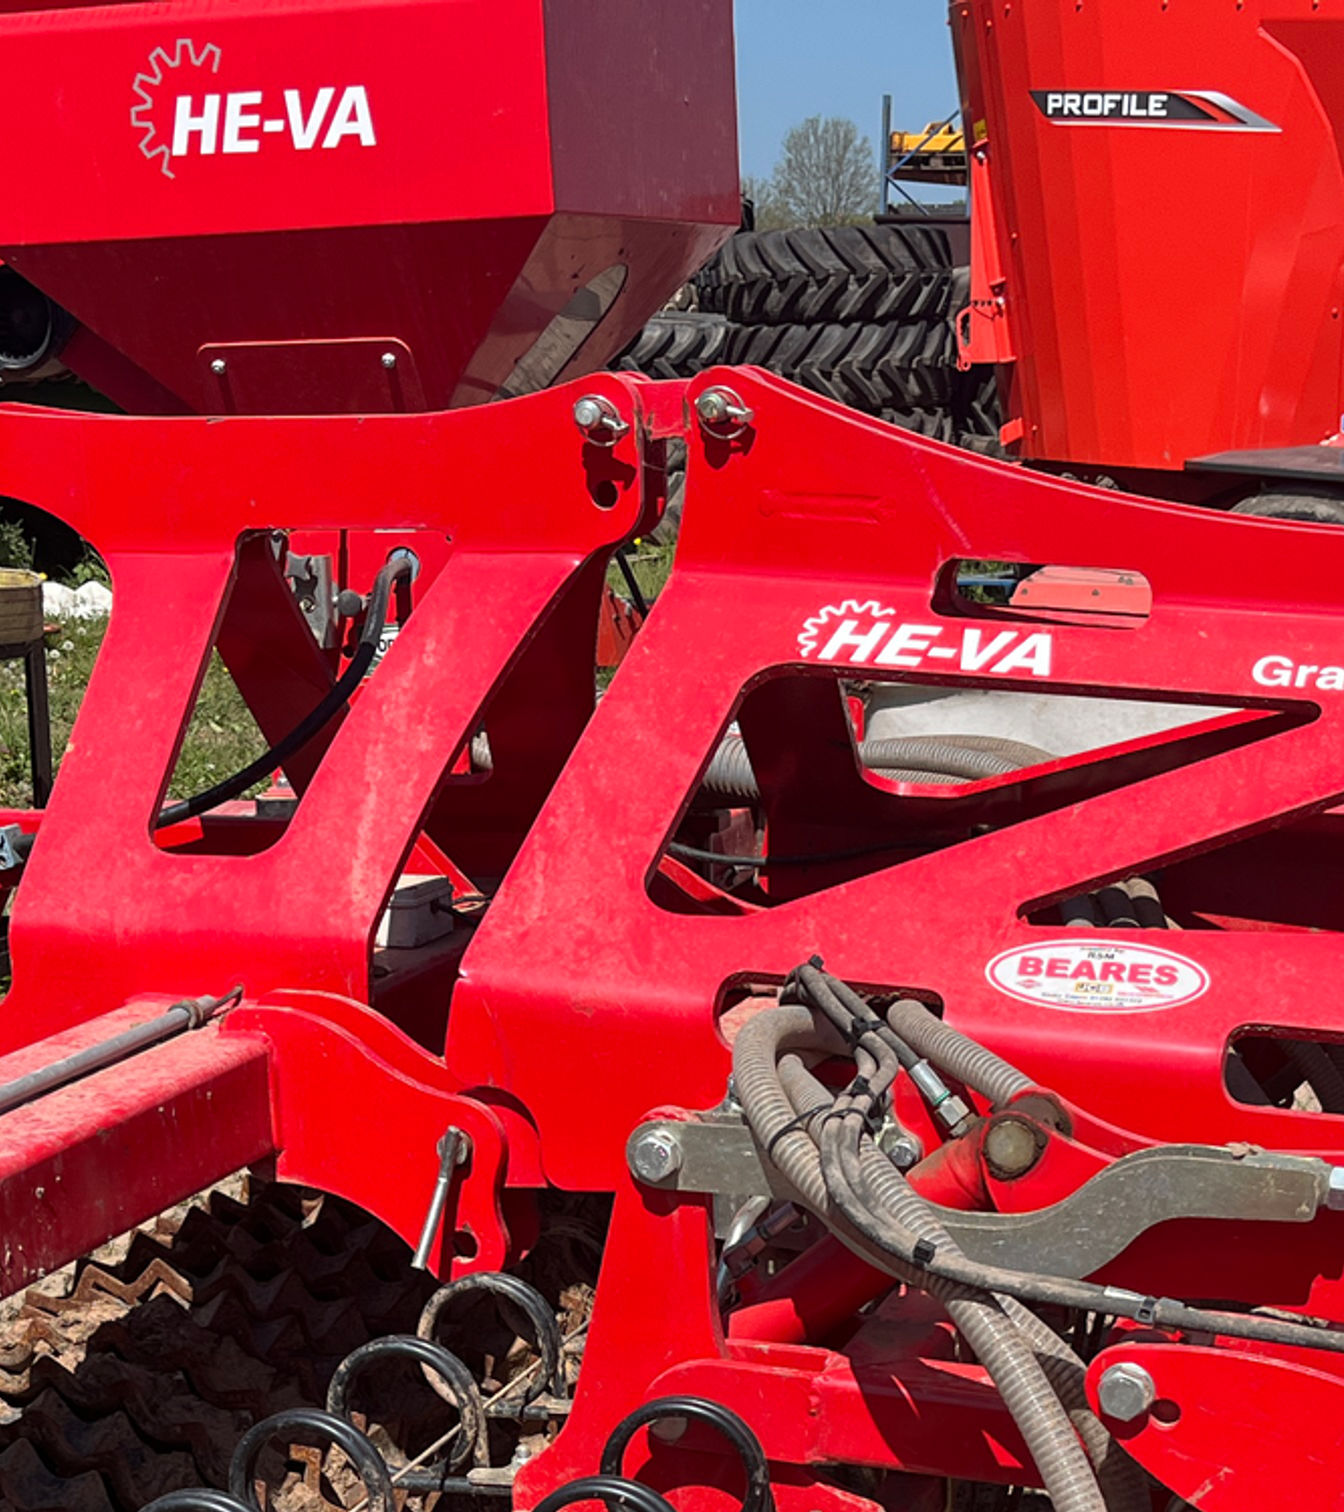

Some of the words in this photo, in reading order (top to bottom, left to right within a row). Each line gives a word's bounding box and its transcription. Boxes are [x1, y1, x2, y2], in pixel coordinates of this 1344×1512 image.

[171, 85, 377, 157] HE-VA
[1046, 93, 1168, 117] PROFILE
[816, 619, 1053, 677] HE-VA
[1016, 956, 1180, 986] BEARES
